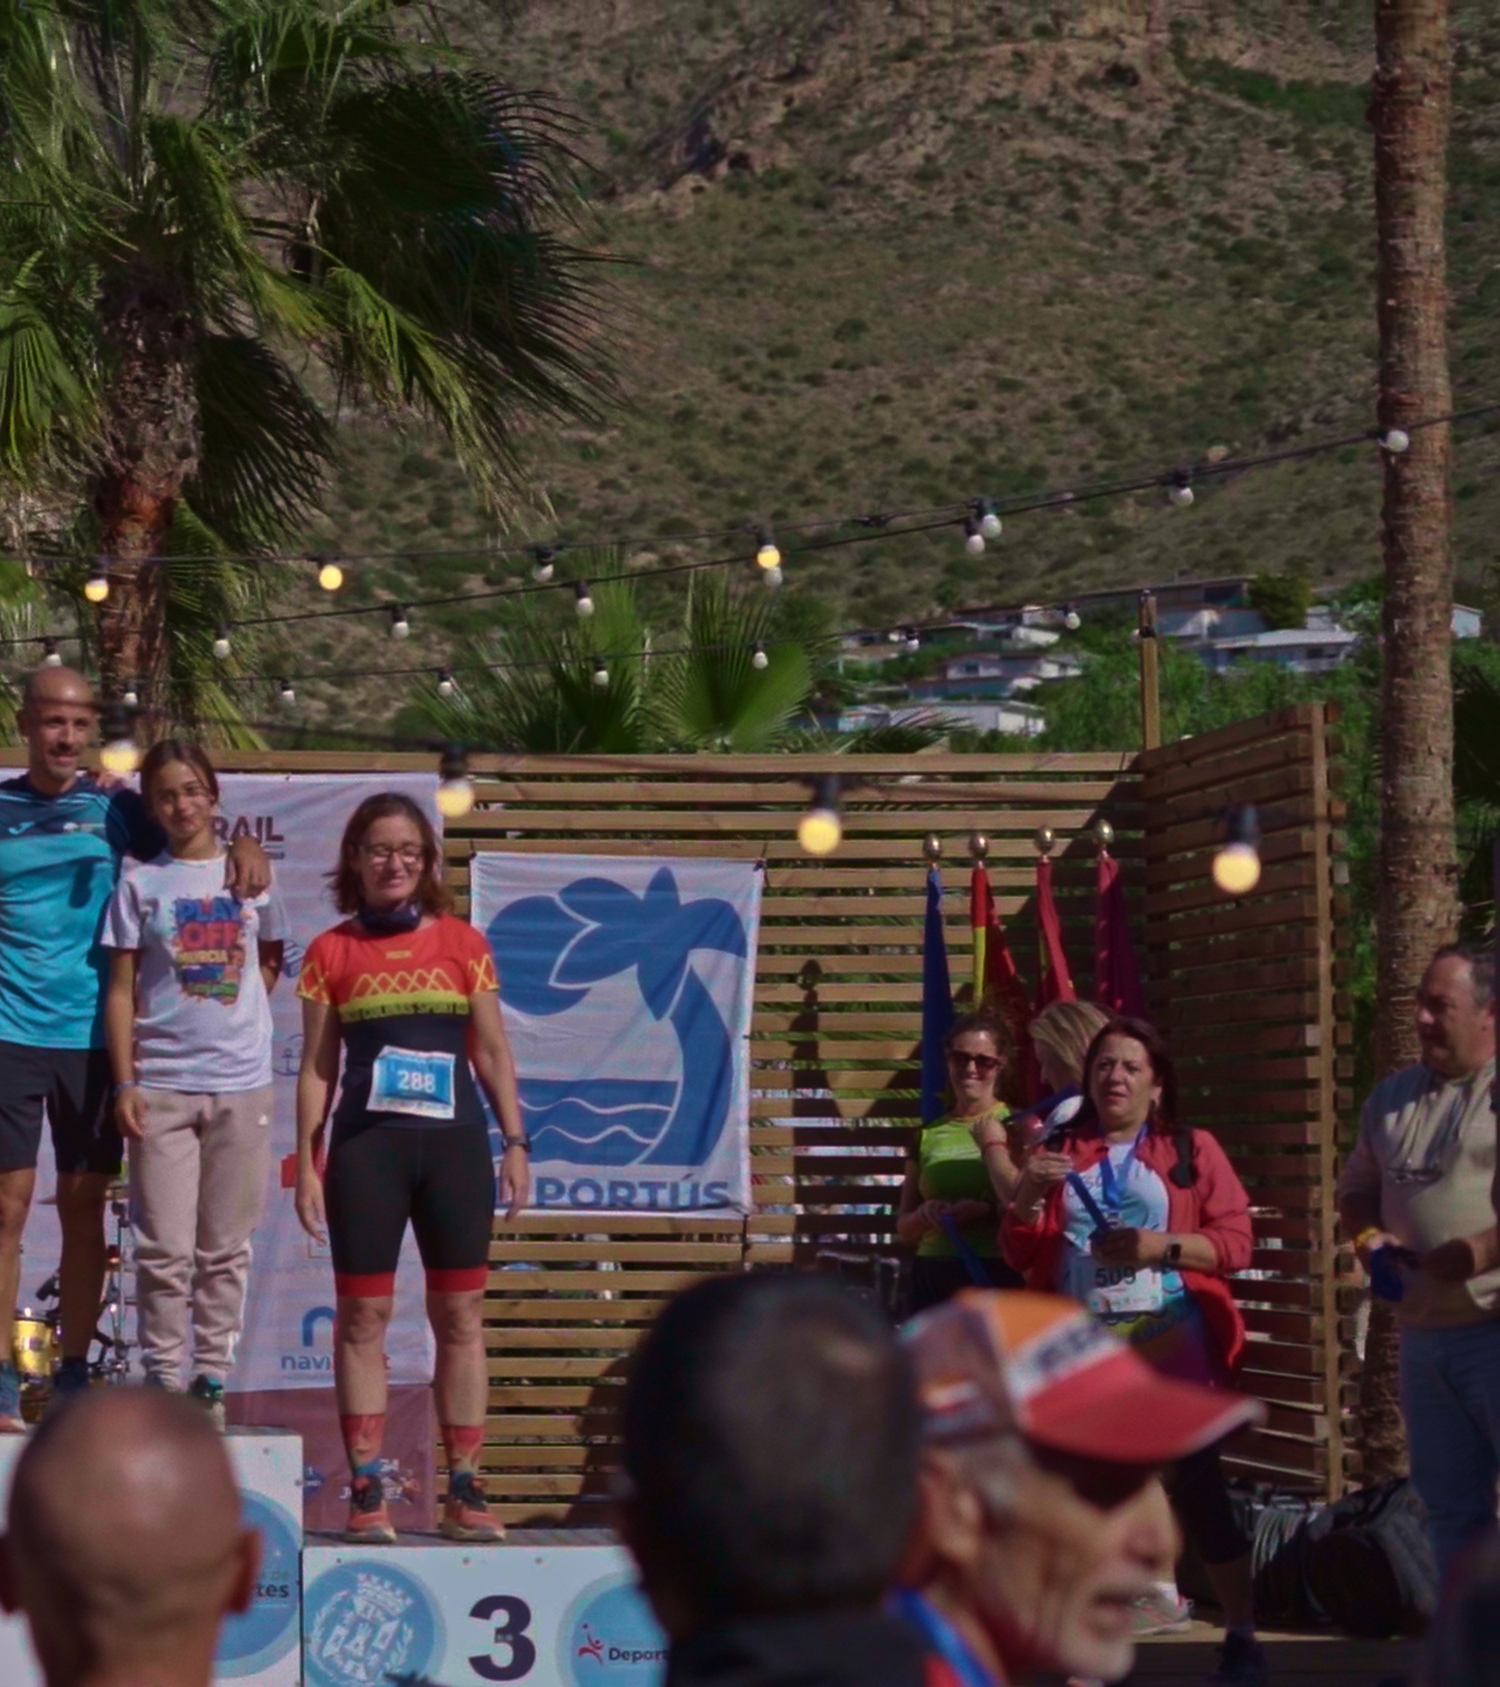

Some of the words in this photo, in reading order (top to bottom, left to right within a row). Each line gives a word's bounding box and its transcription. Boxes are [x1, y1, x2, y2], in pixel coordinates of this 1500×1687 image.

[212, 816, 284, 842] RAIL
[397, 1070, 436, 1093] 288
[536, 1173, 731, 1209] PORTÚS
[1095, 1266, 1136, 1288] 509
[468, 1595, 536, 1681] 3
